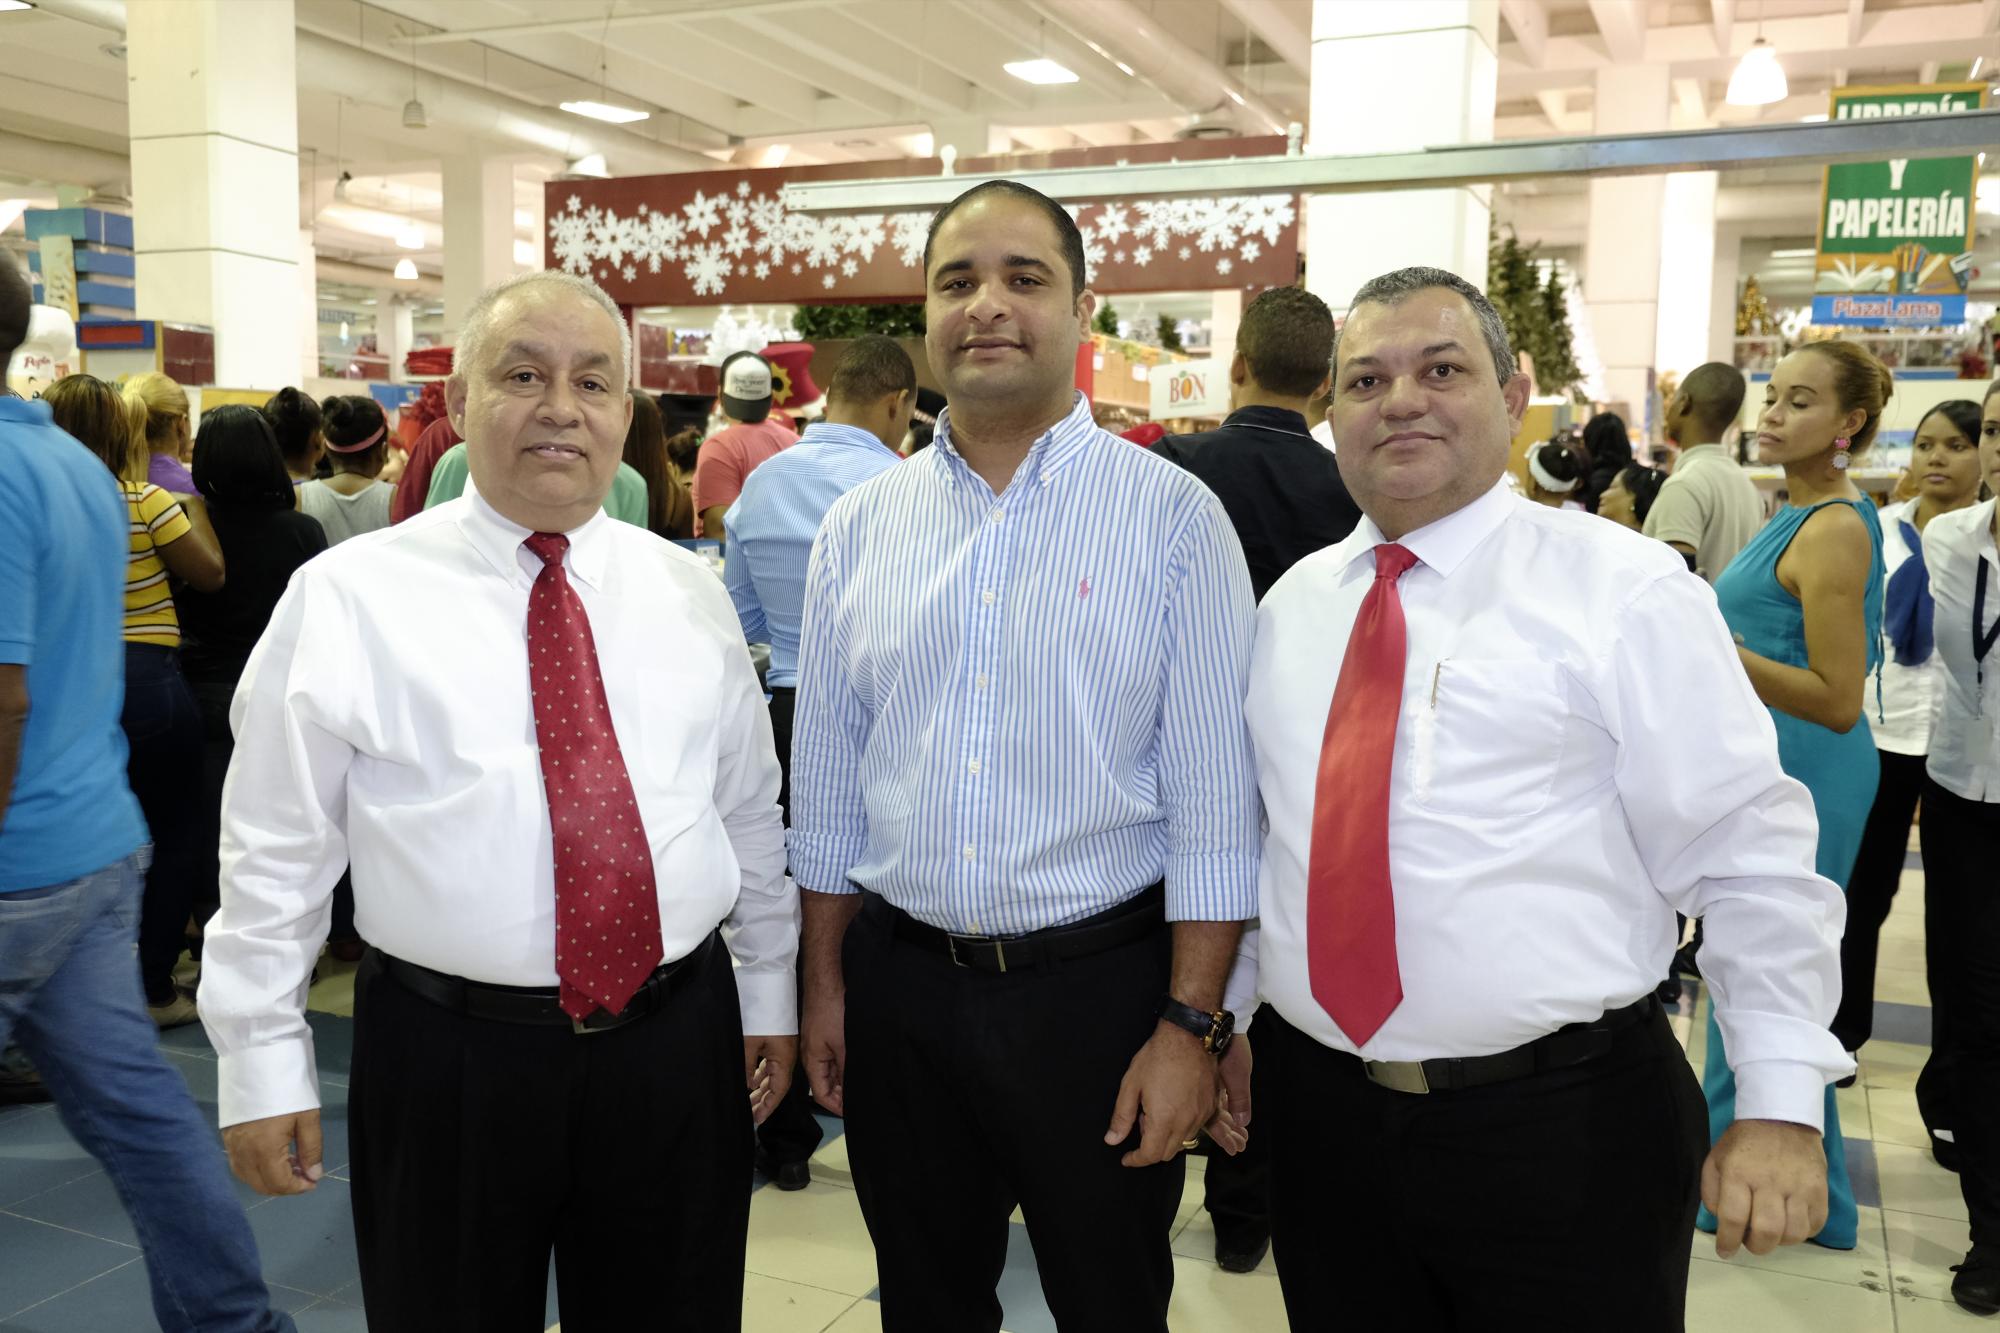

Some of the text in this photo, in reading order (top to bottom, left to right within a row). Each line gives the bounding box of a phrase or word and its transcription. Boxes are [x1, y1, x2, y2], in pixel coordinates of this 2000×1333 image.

[1889, 159, 1908, 190] Y
[1826, 190, 1966, 239] PAPELERÍA
[1169, 372, 1207, 404] BON
